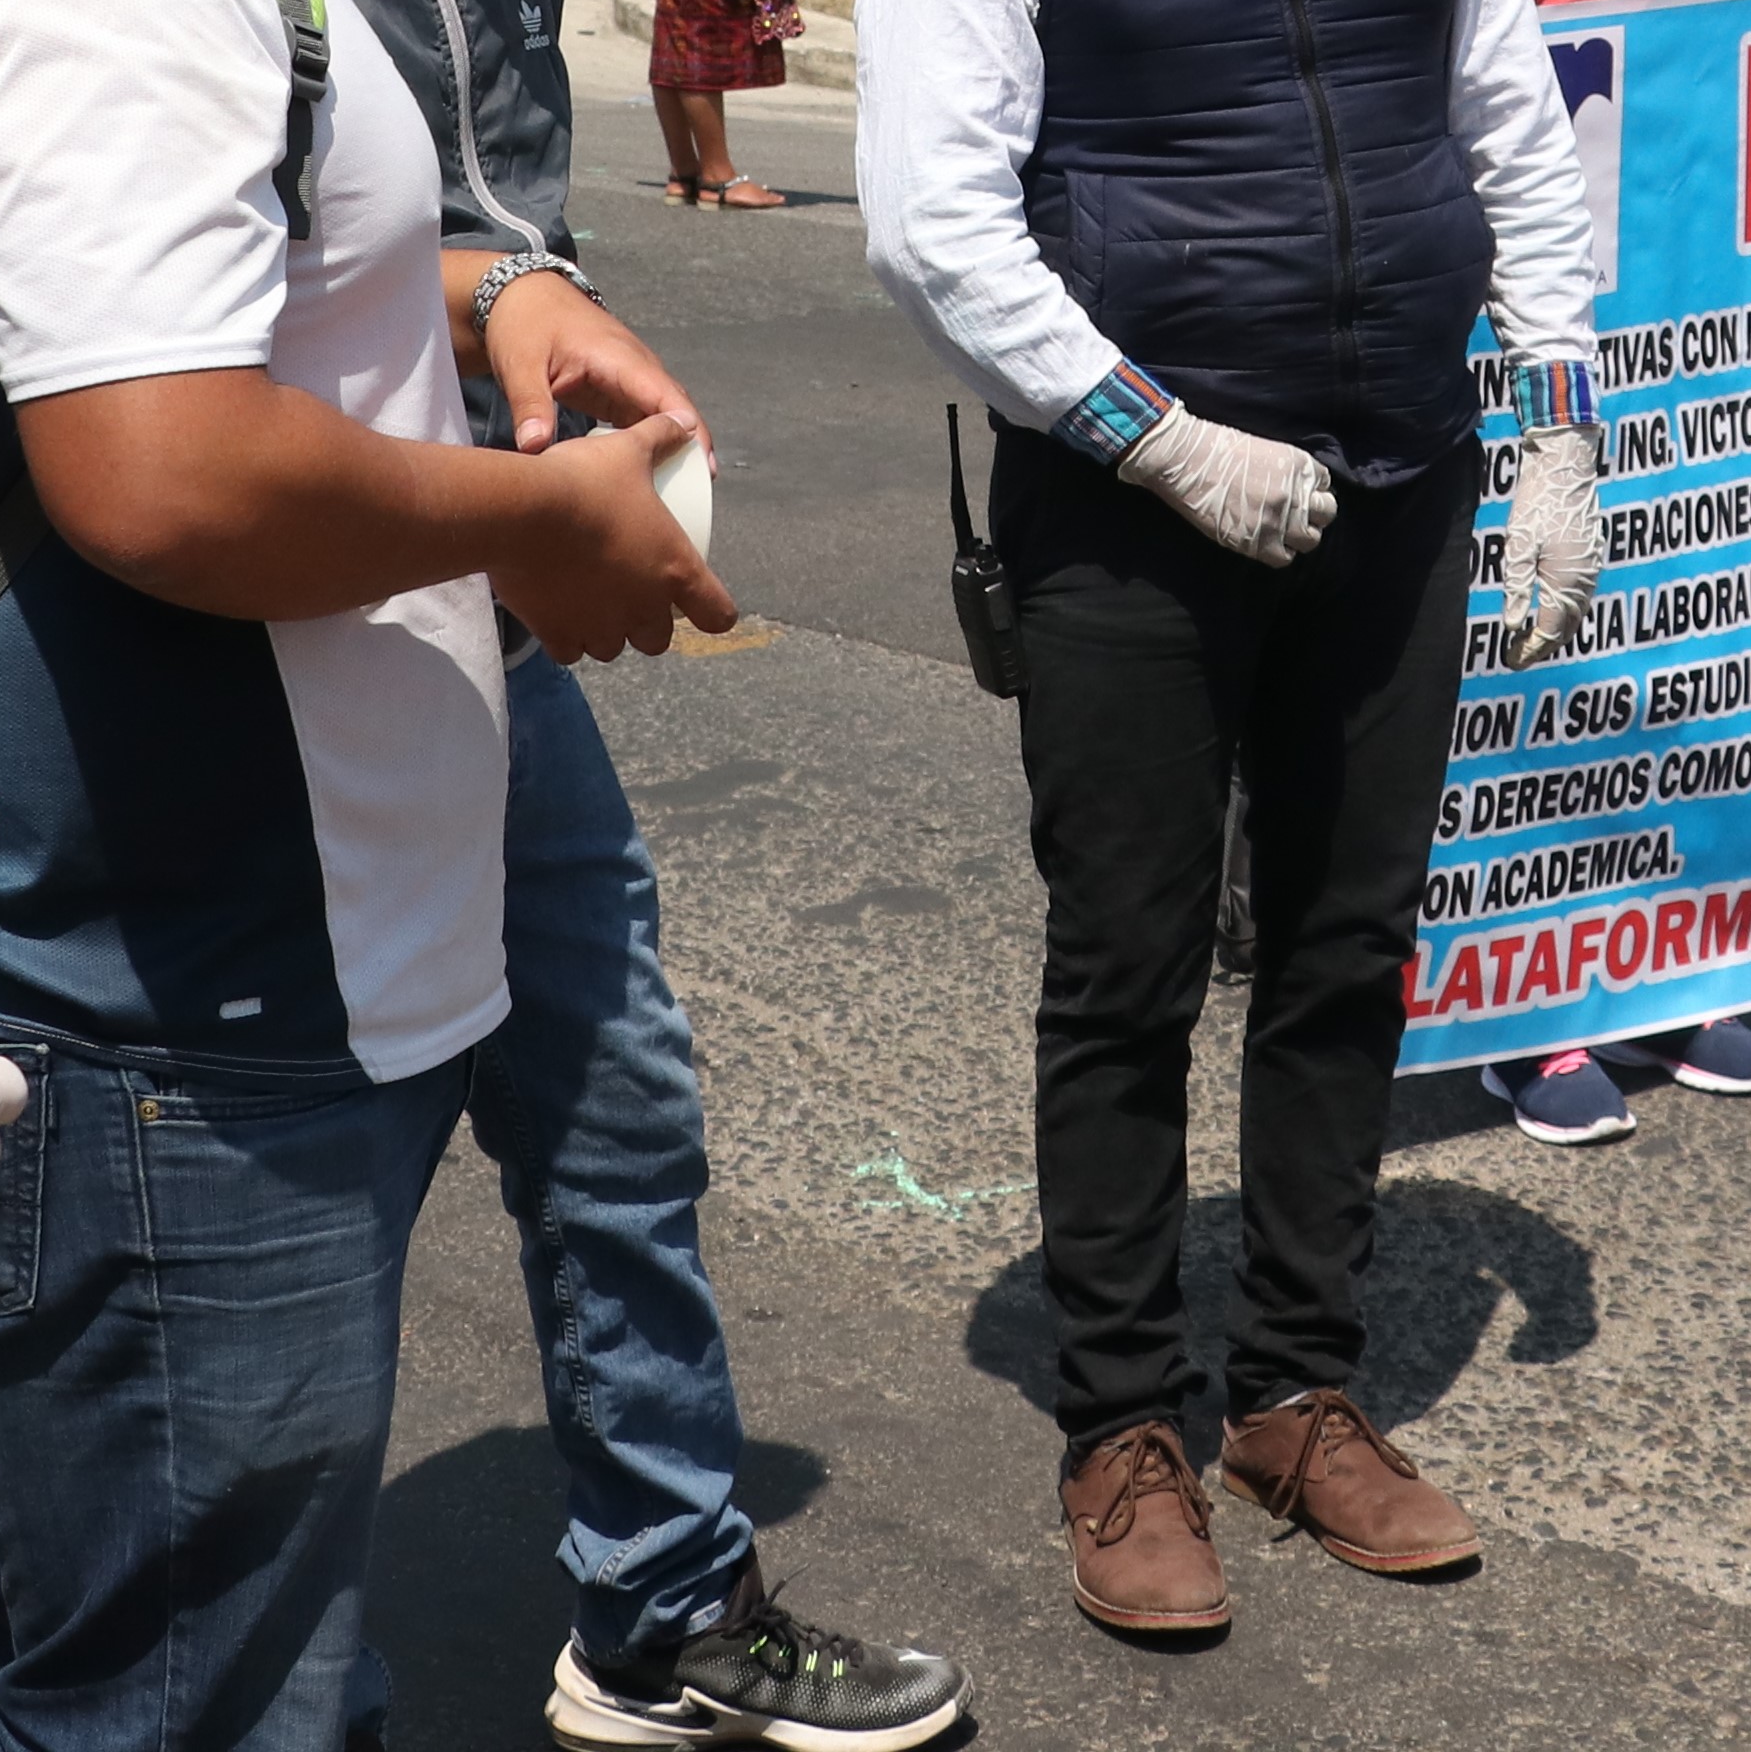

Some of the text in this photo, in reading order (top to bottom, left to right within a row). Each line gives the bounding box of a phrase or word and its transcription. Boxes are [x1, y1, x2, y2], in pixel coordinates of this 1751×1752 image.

[523, 34, 551, 51] adidas
[1682, 313, 1737, 373] CON
[1618, 415, 1674, 473] ING.
[1530, 695, 1555, 743] A
[1564, 682, 1634, 739] SUS
[1470, 757, 1652, 834] DERECHOS
[1481, 830, 1680, 913] ACADEMICA.
